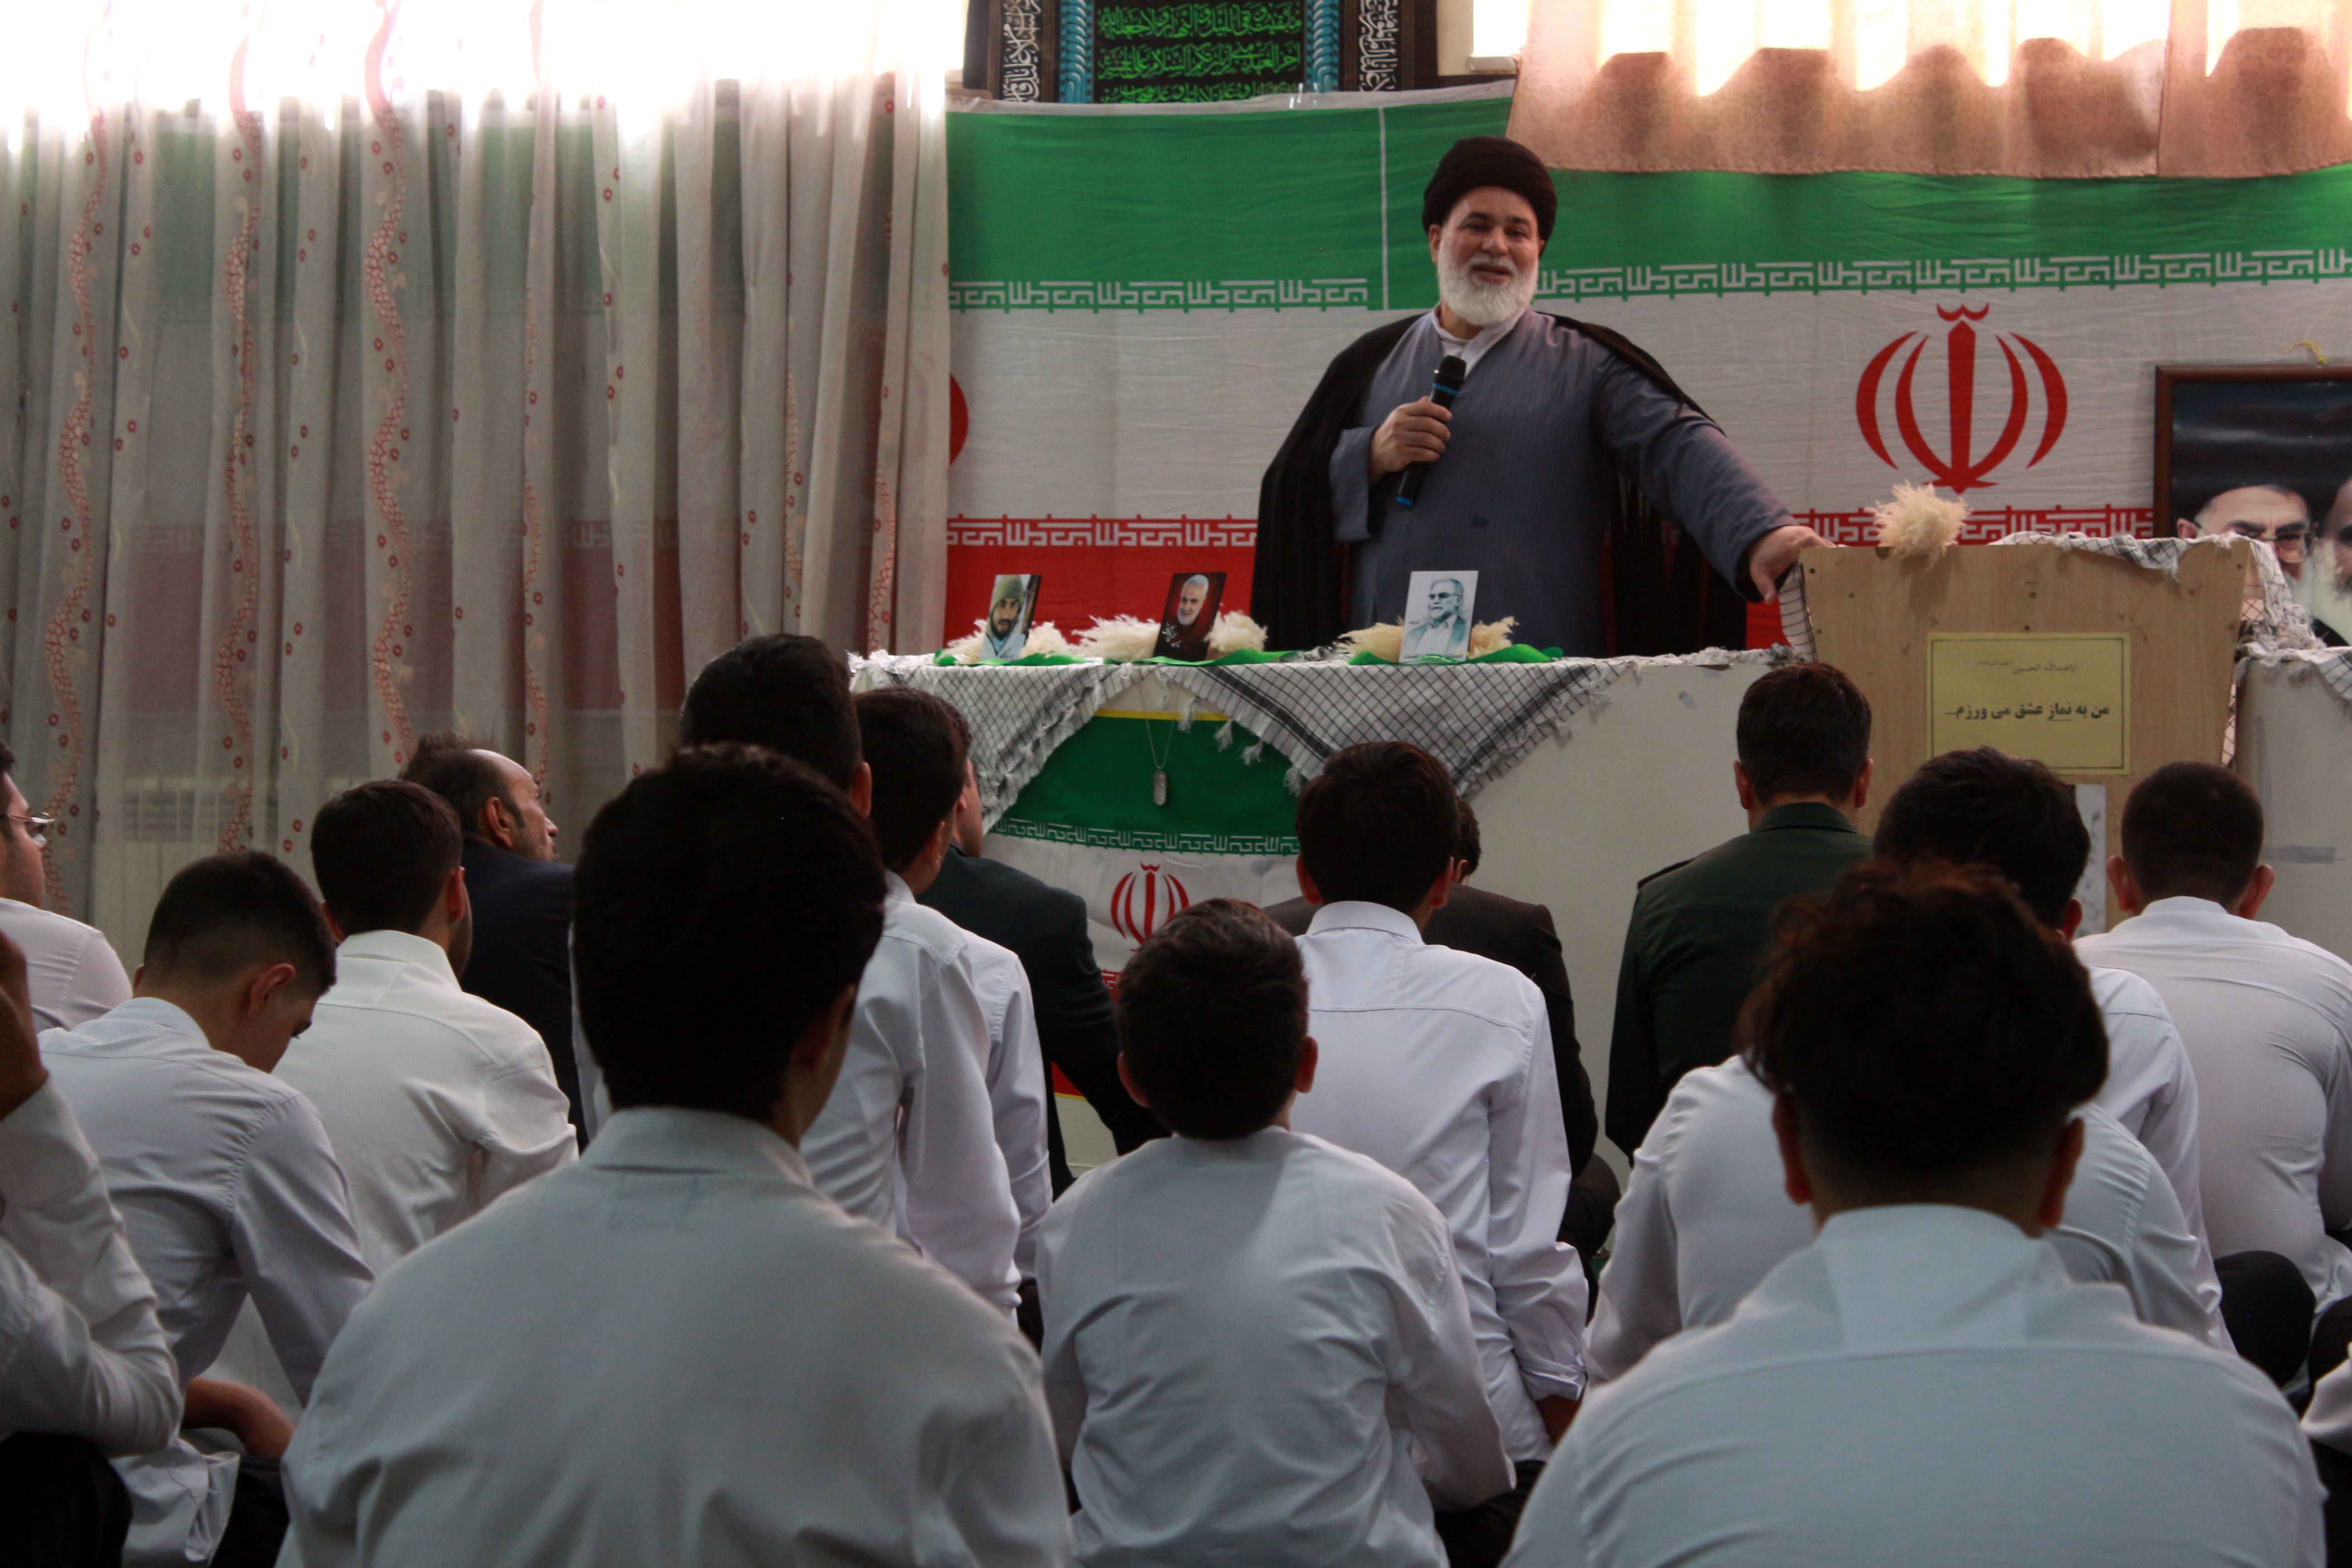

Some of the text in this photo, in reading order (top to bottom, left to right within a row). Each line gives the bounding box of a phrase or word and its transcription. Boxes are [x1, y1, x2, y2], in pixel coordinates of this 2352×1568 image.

[2015, 703, 2043, 719] عشق
[2047, 702, 2072, 720] نماز
[2075, 706, 2087, 718] به
[2091, 706, 2109, 719] من
